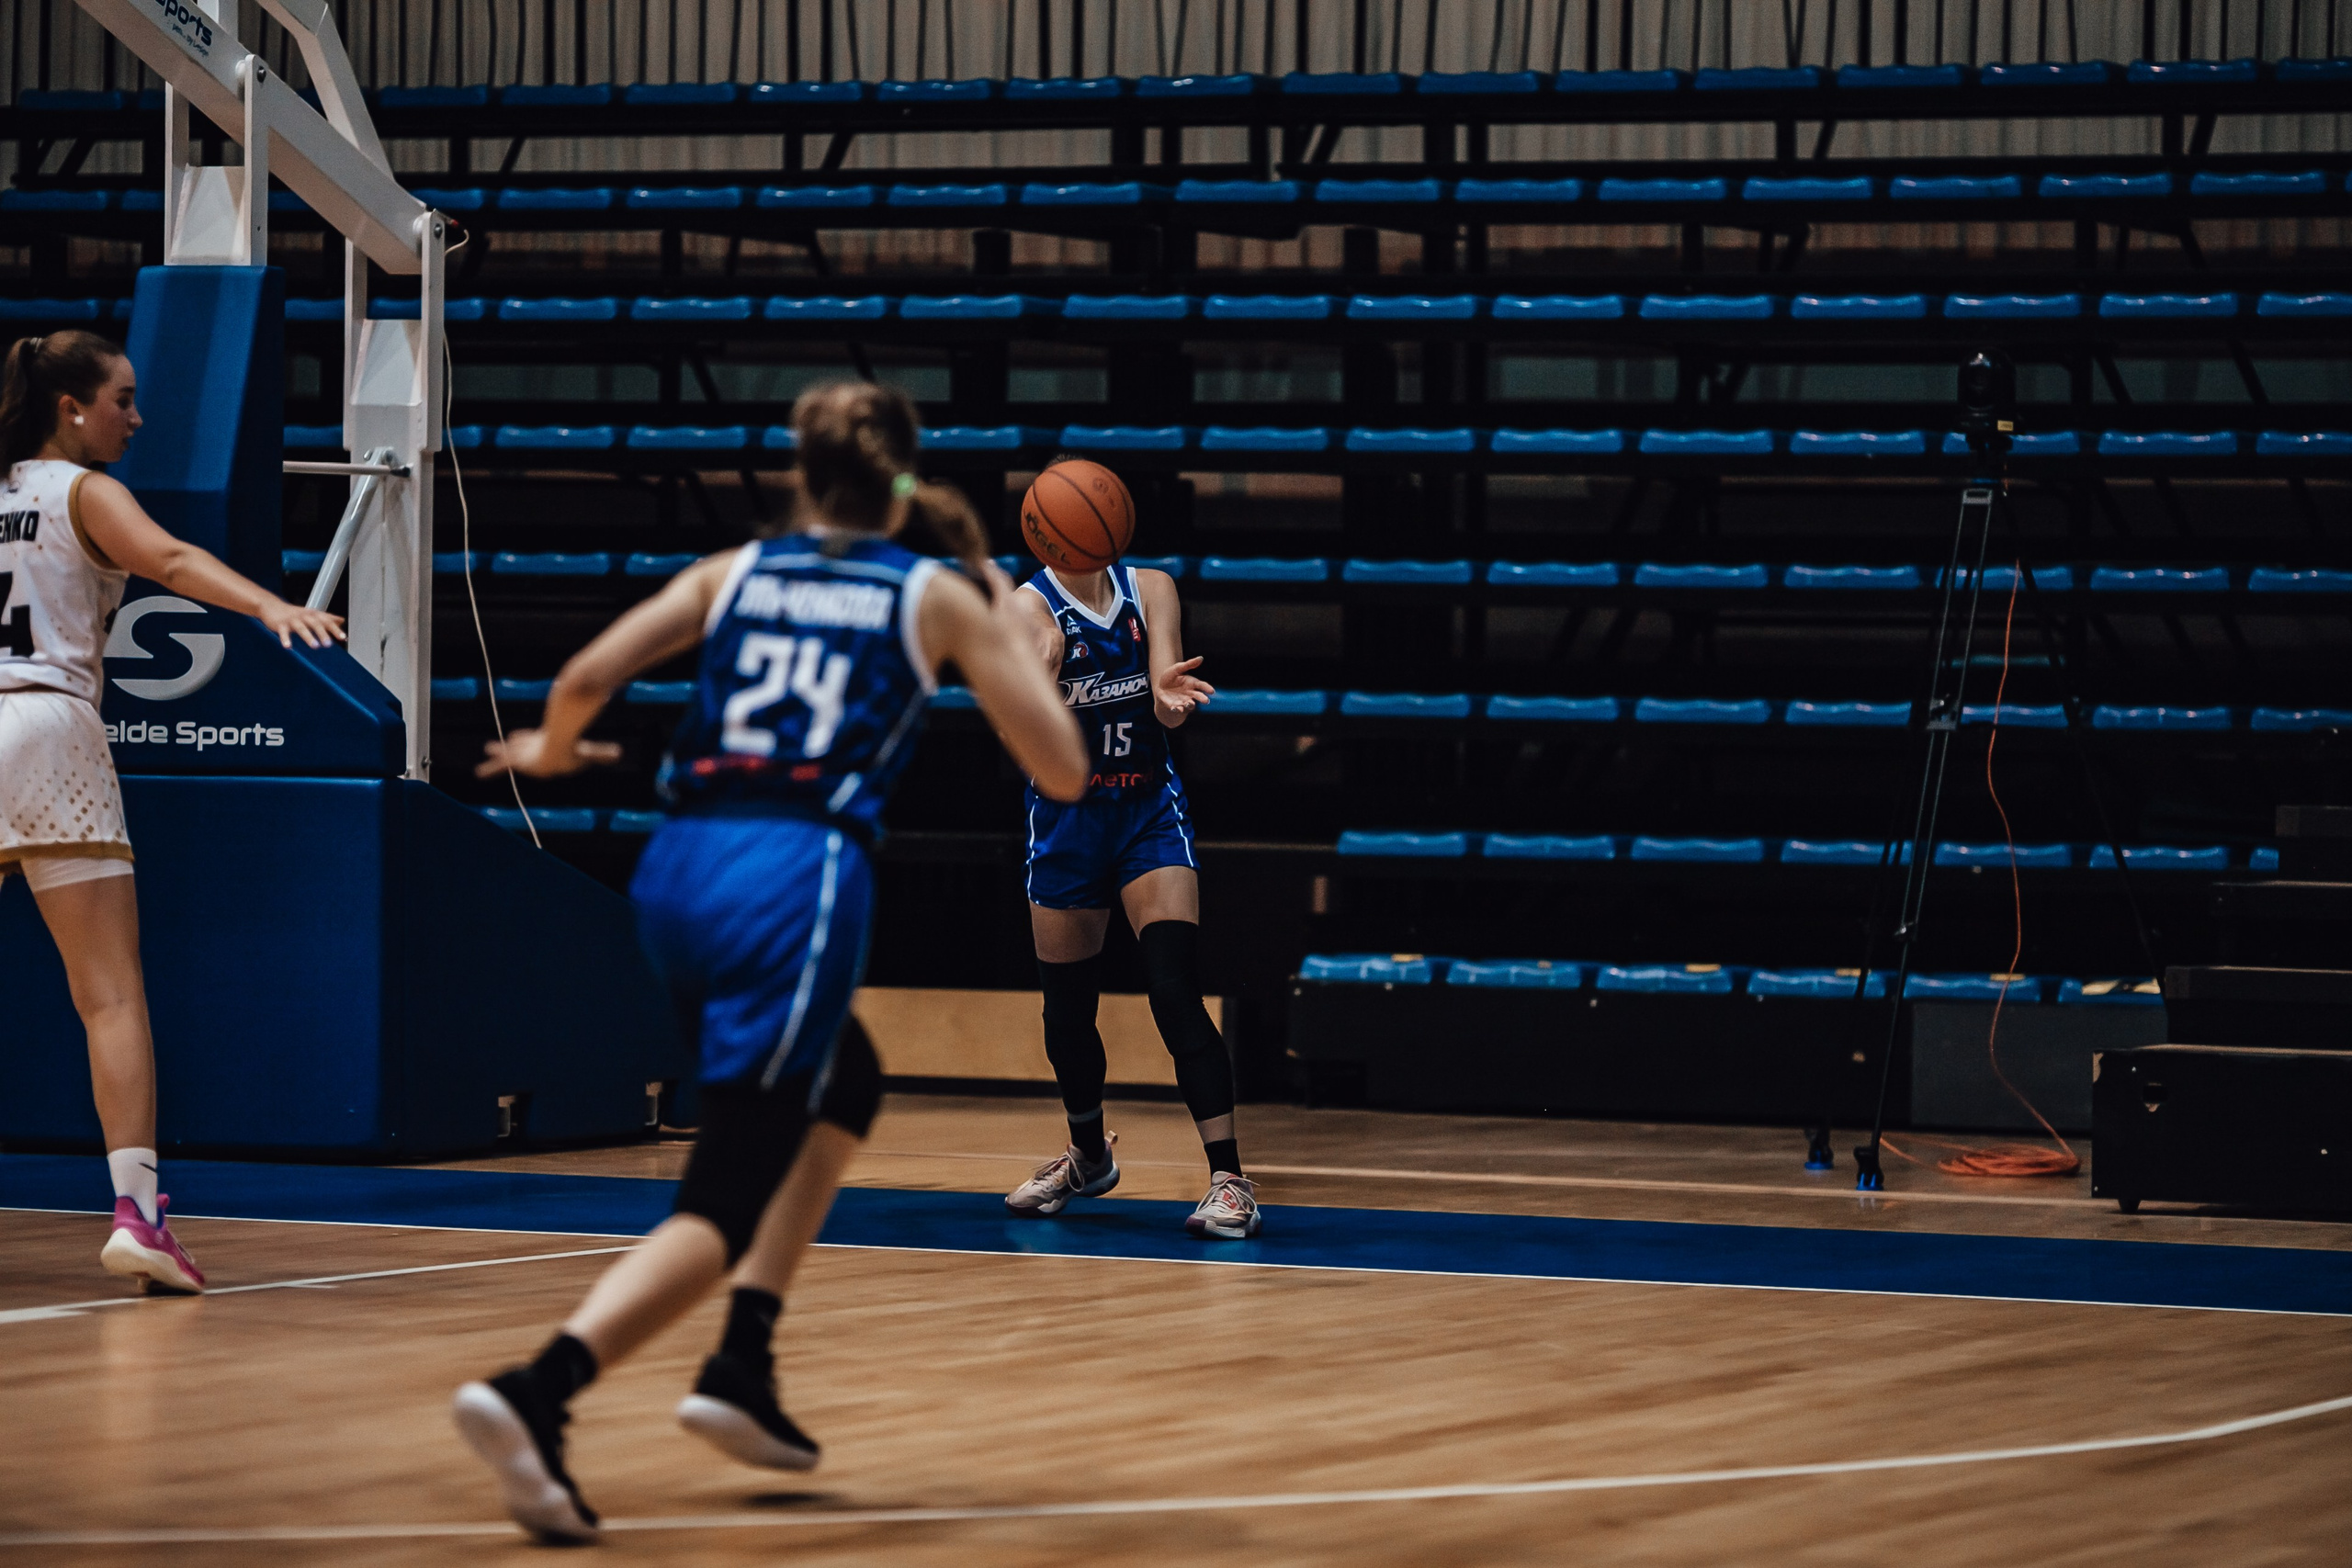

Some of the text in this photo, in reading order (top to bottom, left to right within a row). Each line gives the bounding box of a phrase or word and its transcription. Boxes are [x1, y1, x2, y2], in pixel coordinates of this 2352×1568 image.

[720, 629, 854, 760] 24
[175, 722, 285, 751] Sports
[1102, 722, 1133, 757] 15
